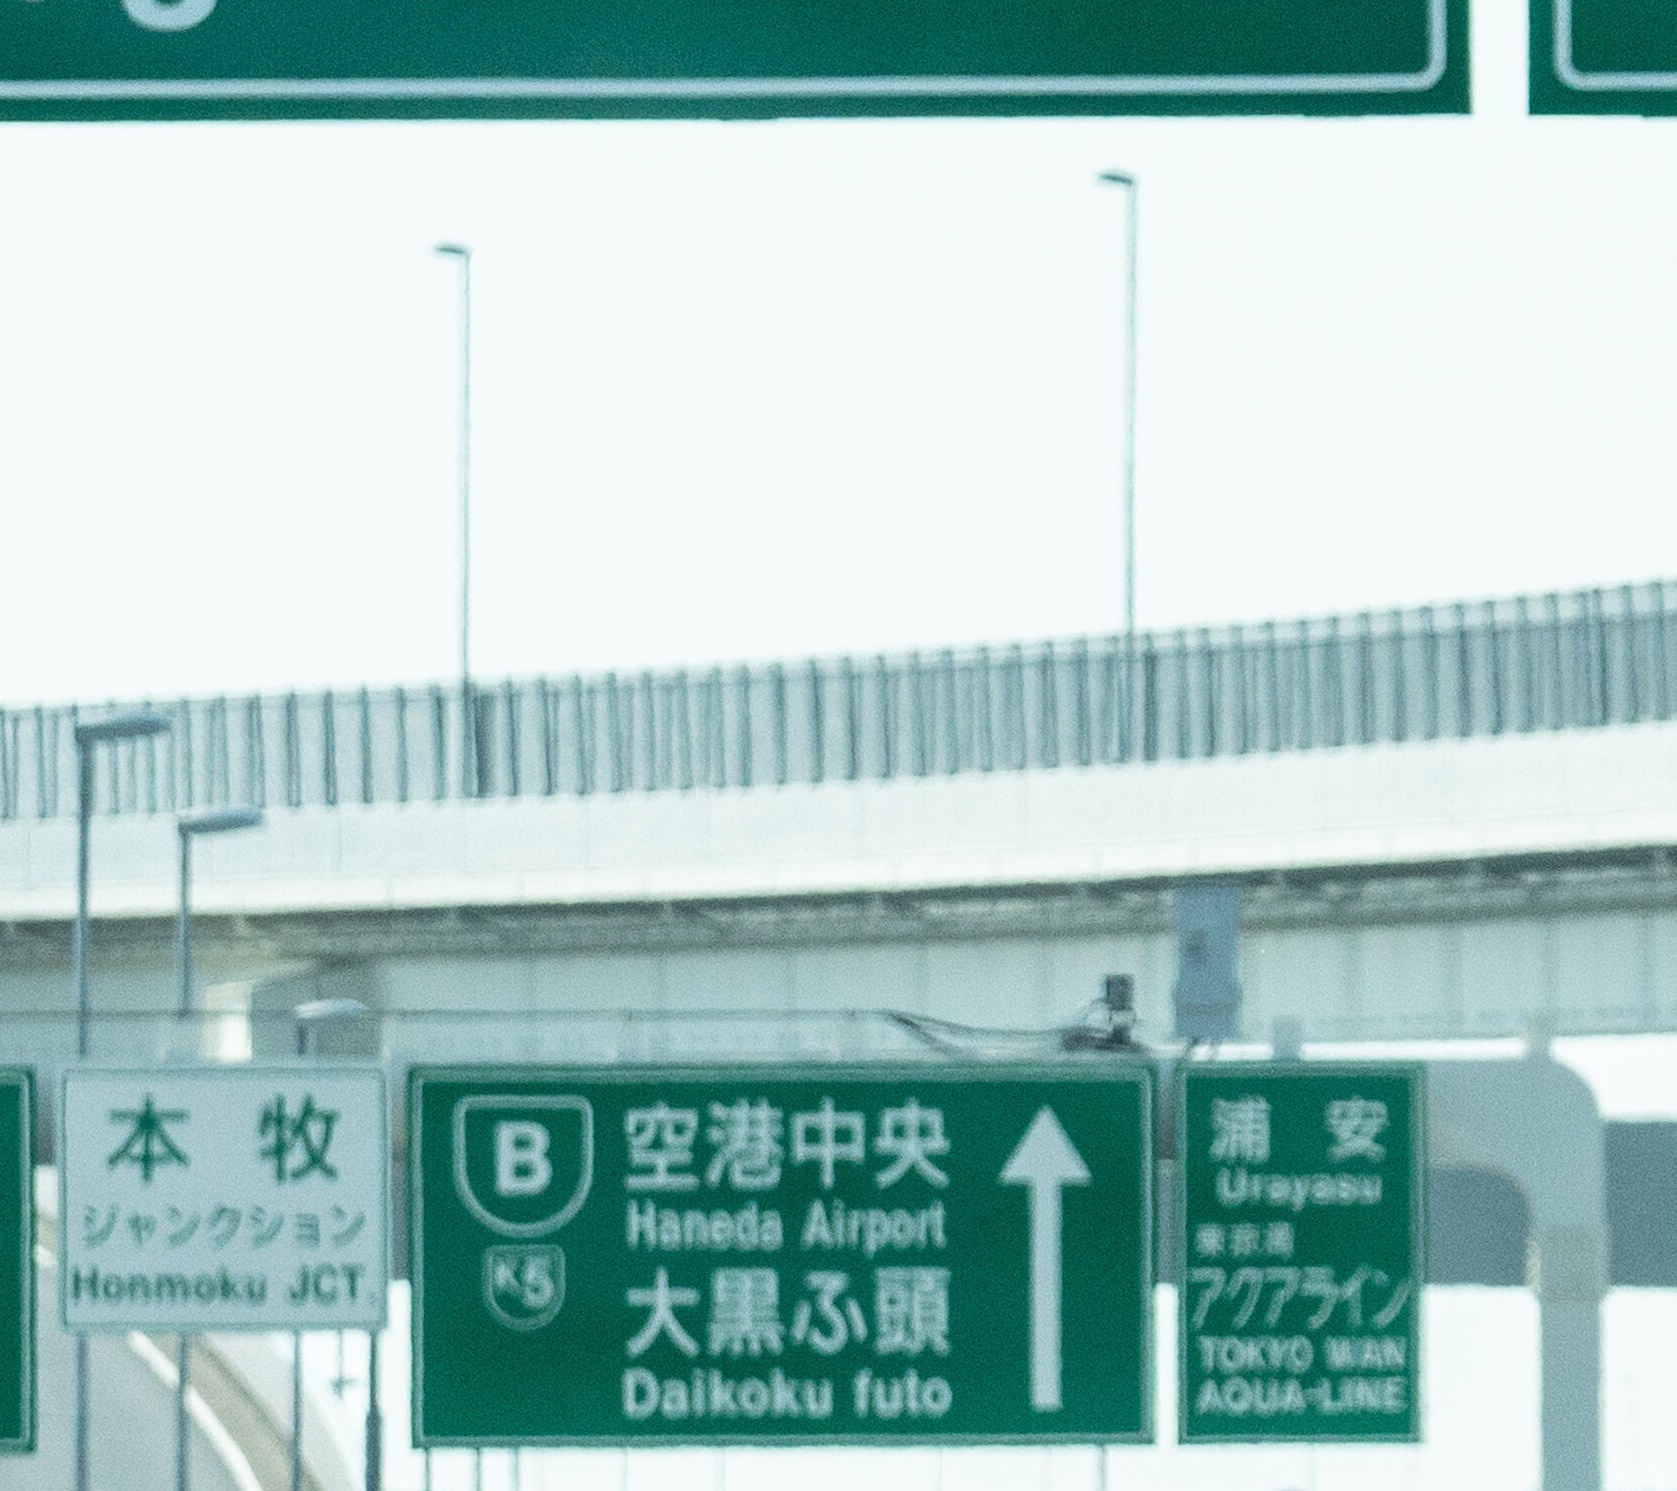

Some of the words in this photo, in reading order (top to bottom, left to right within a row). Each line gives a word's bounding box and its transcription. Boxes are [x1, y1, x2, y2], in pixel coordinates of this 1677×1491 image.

[106, 1093, 341, 1186] 本牧
[625, 1099, 949, 1190] 空港中央
[1211, 1097, 1387, 1161] 浦安
[496, 1122, 551, 1195] B
[1217, 1169, 1382, 1210] Urayasu
[82, 1204, 367, 1250] ジャンクション
[627, 1201, 783, 1250] Haneda
[802, 1201, 945, 1254] Airport
[71, 1266, 267, 1303] Honmoku
[628, 1267, 949, 1355] 大黒ふ頭
[1191, 1265, 1411, 1330] アクアライン
[1200, 1336, 1313, 1374] TOKYO
[1326, 1337, 1405, 1369] WAN
[623, 1368, 832, 1418] Daikoku
[854, 1370, 952, 1418] futo
[1197, 1376, 1405, 1415] AQUA-LINE
